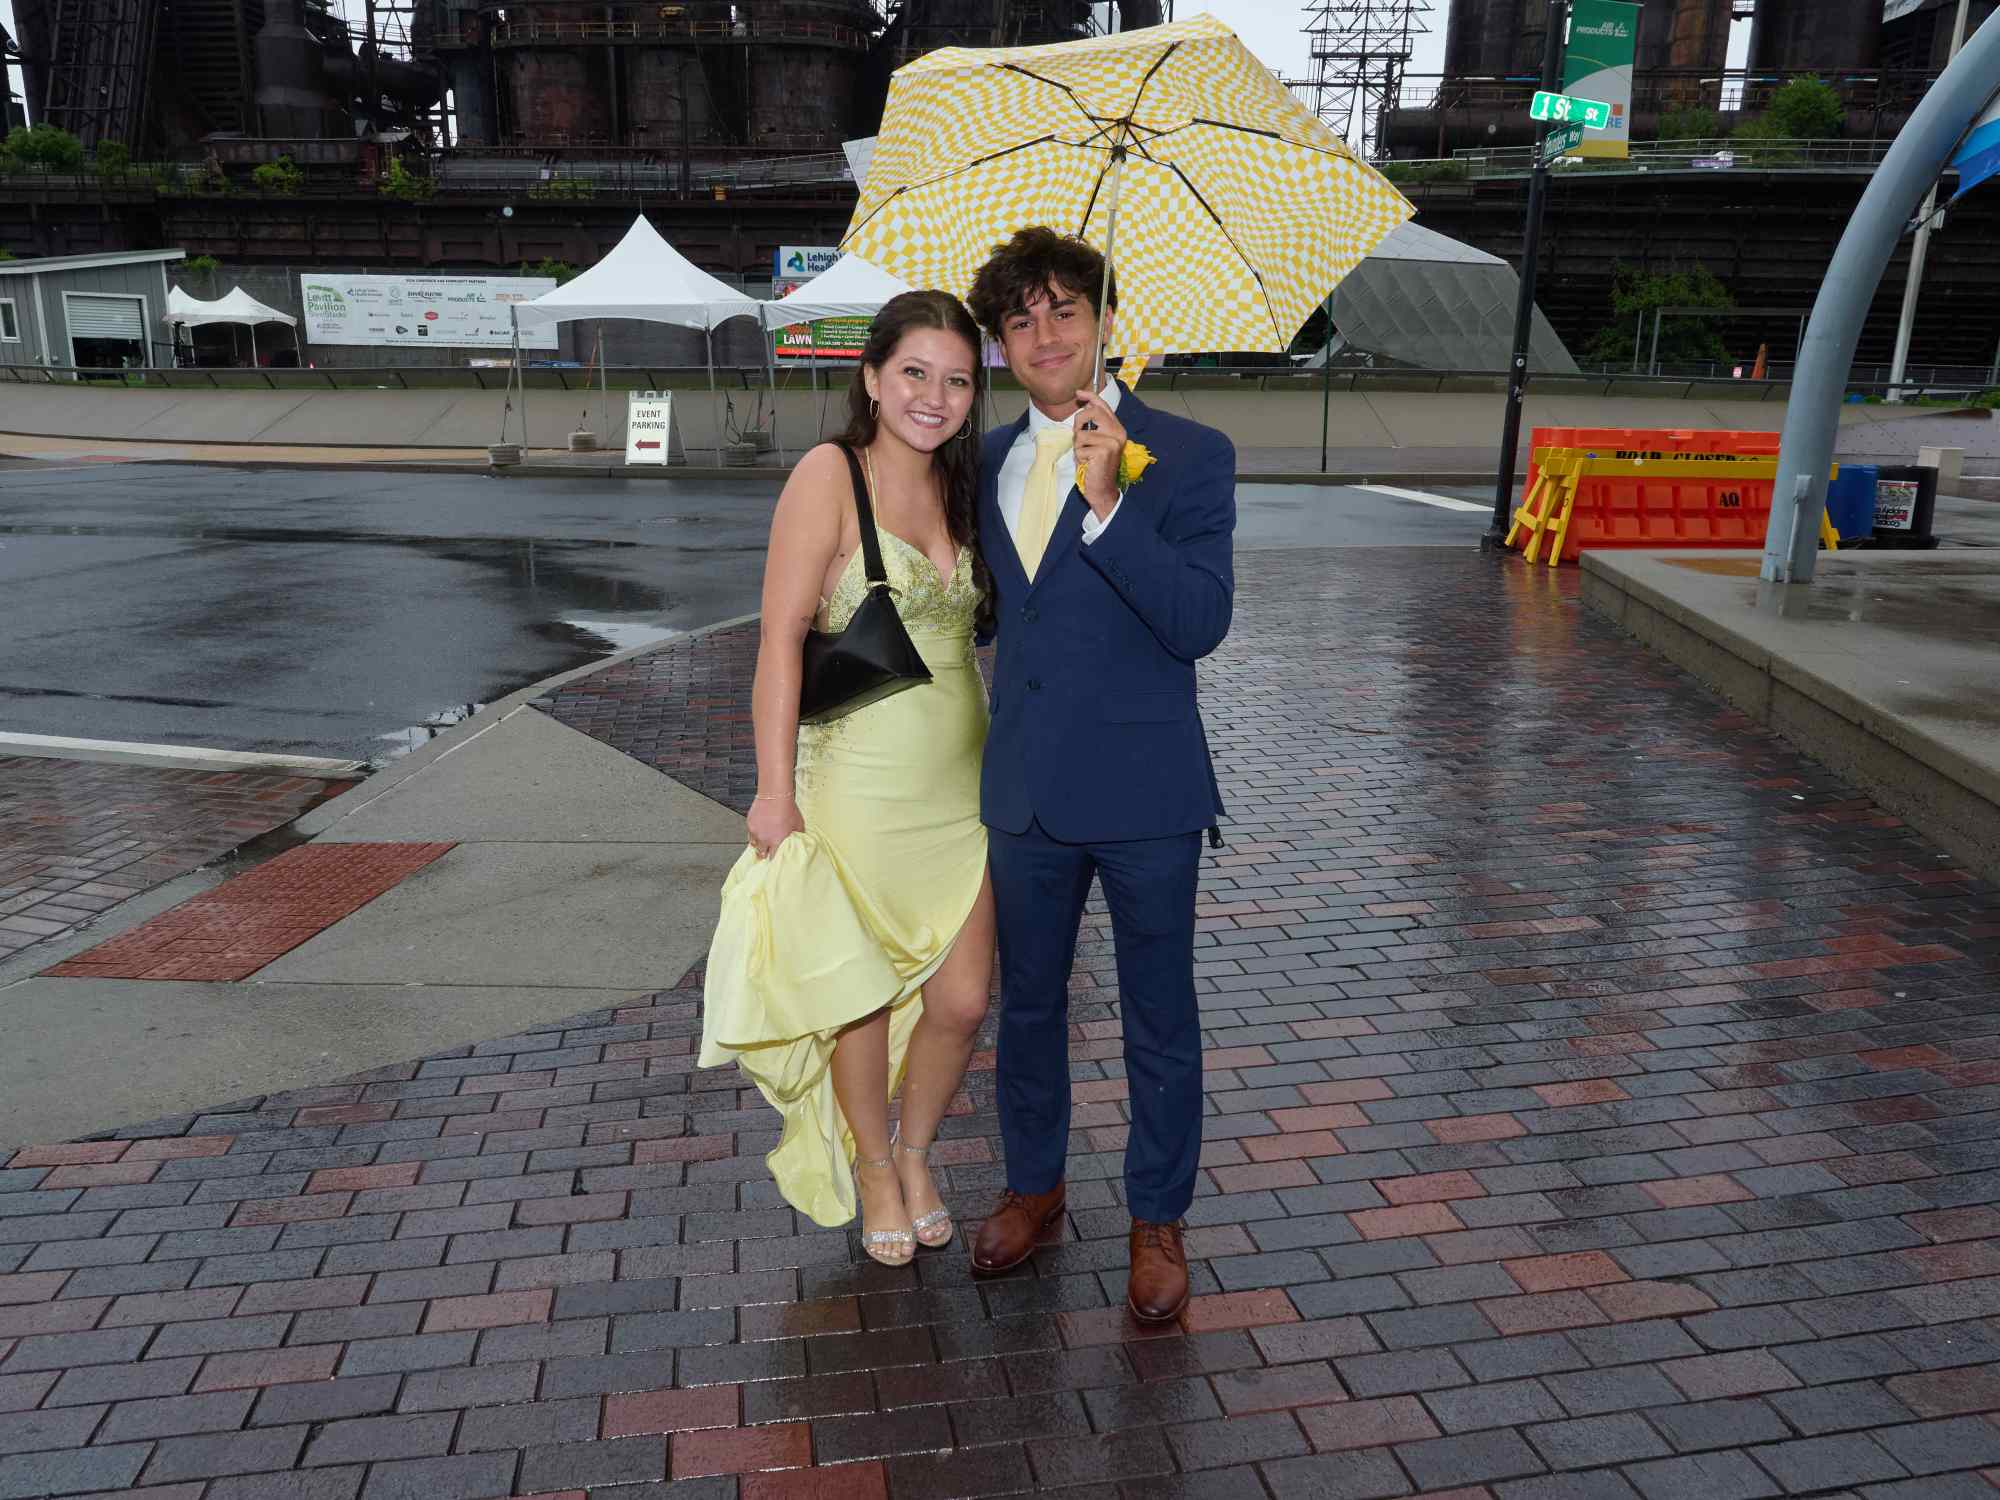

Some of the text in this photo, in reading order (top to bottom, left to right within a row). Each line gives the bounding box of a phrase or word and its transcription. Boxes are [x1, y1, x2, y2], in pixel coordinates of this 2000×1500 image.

[1569, 129, 1581, 143] Way
[807, 252, 838, 263] Lehigh
[306, 292, 333, 302] Levitt
[308, 302, 346, 312] Pavilion
[783, 334, 812, 345] LAWN
[637, 410, 661, 418] EVENT
[632, 421, 666, 430] PARKING
